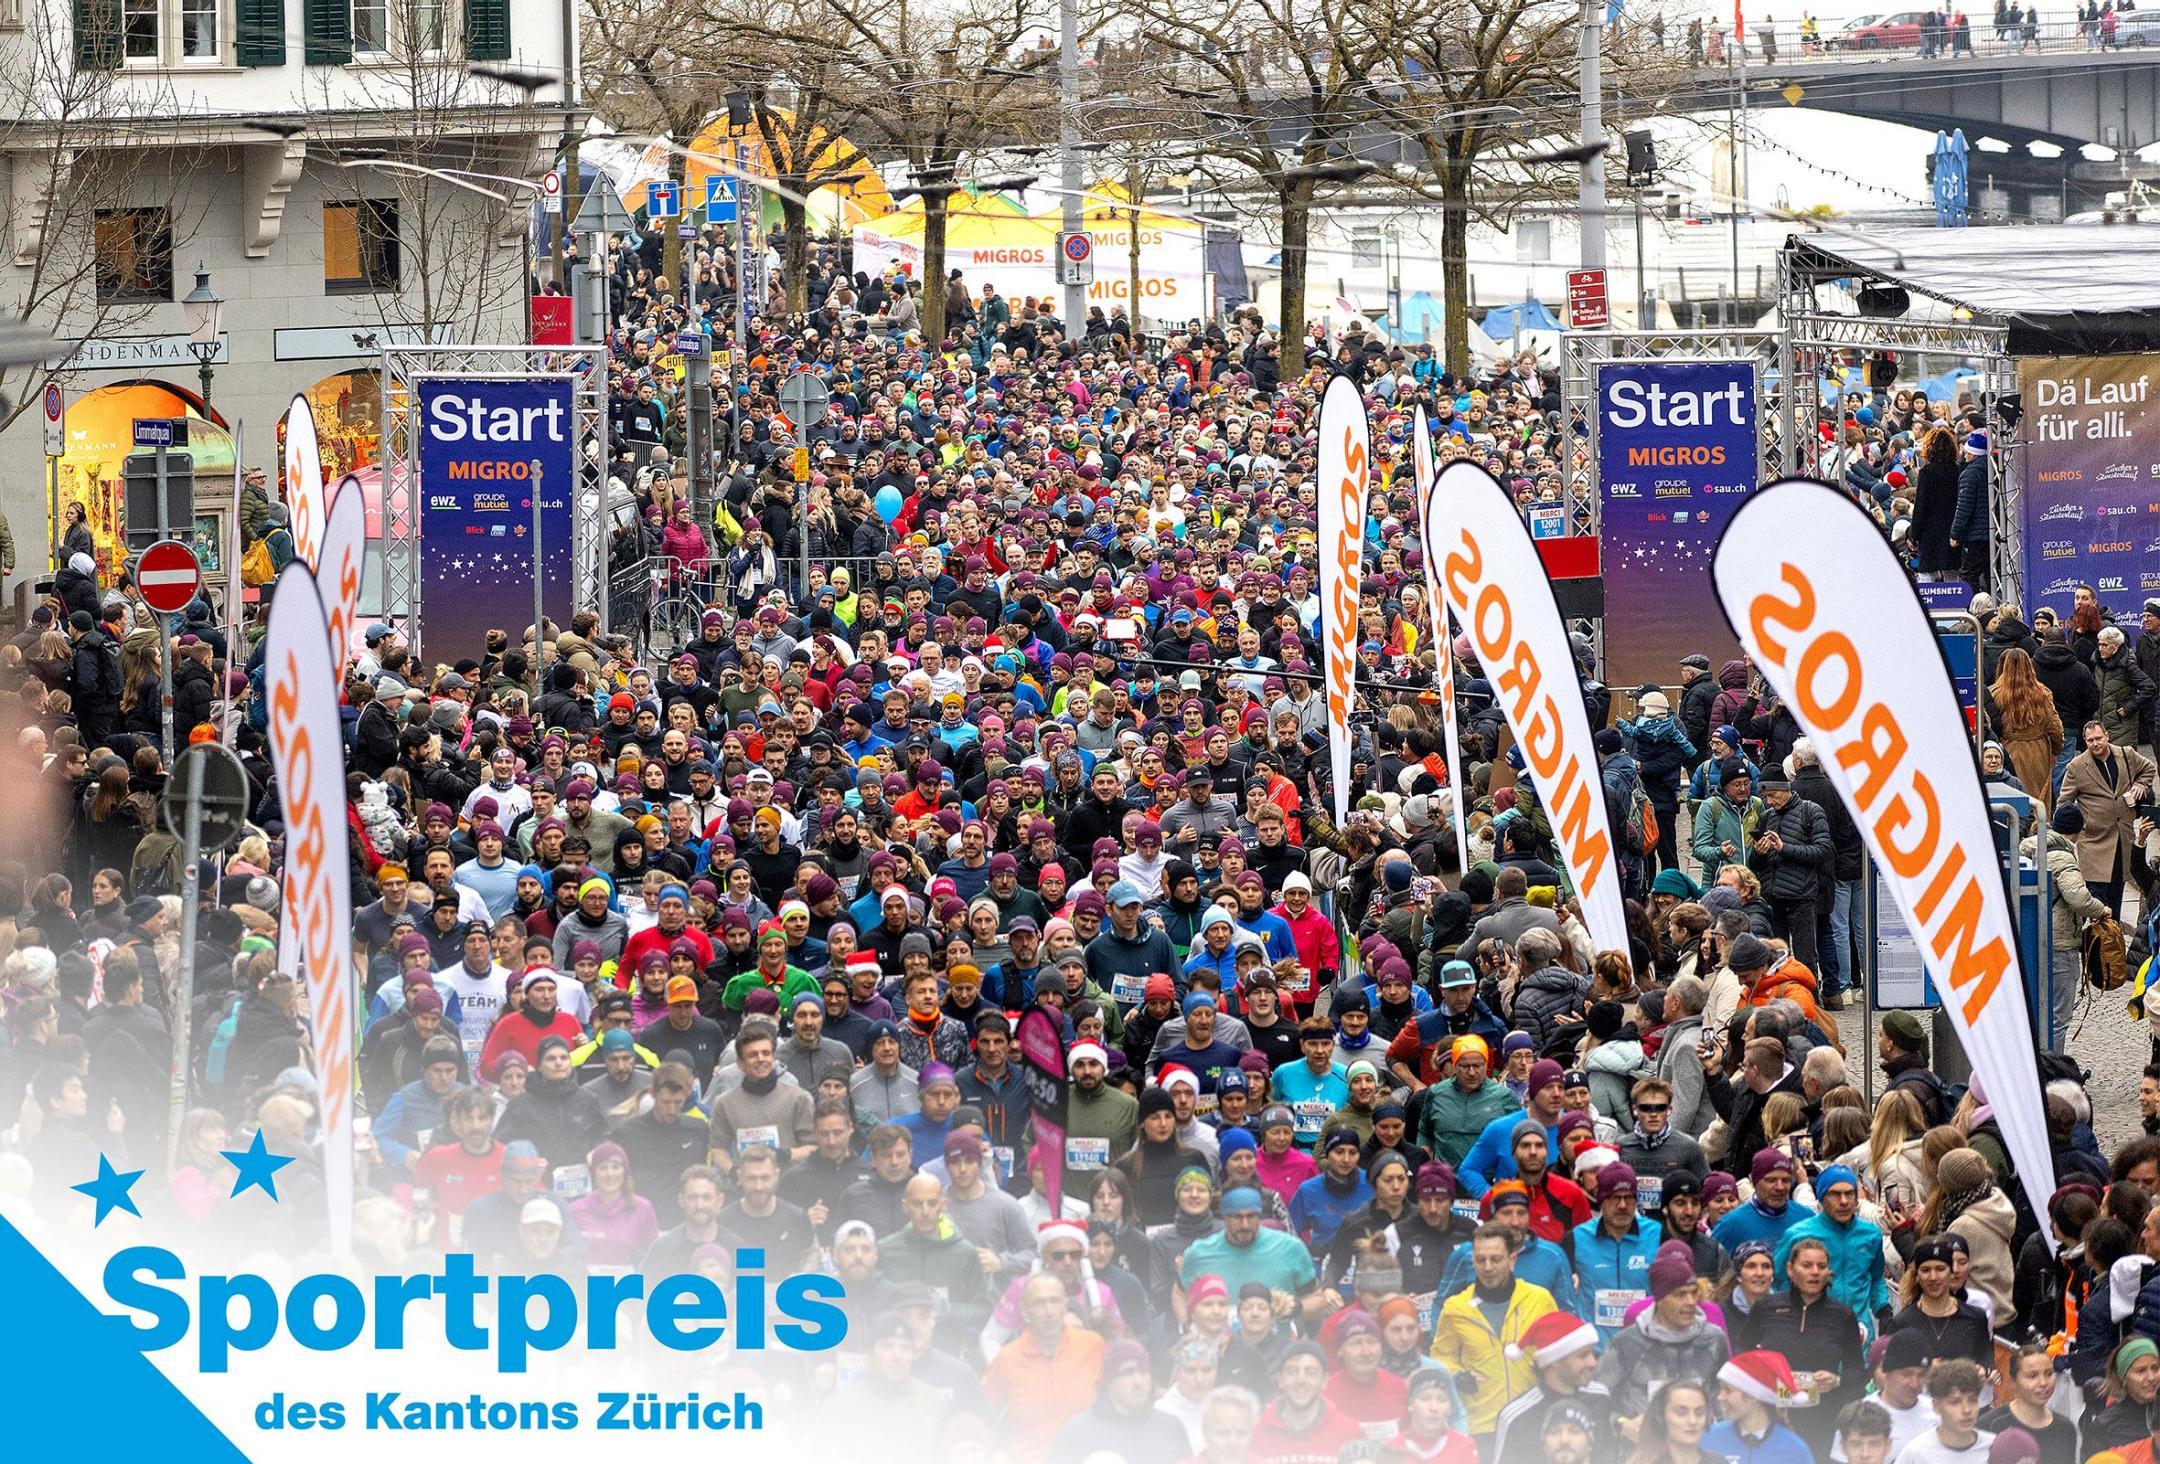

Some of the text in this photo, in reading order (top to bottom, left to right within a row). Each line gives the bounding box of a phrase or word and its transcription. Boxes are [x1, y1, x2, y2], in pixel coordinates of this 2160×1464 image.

[974, 249, 1045, 264] MIGROS
[2037, 374, 2149, 407] Dä Lauf
[1608, 380, 1746, 428] Start
[430, 394, 564, 442] Start
[2037, 411, 2133, 442] für alli.
[1629, 446, 1726, 467] MIGROS
[2038, 470, 2083, 482] MIGROS
[1610, 483, 1637, 494] ewz
[1655, 479, 1687, 489] groupe
[1714, 483, 1747, 493] sau.ch
[1655, 486, 1691, 496] mutuel
[430, 494, 457, 506] ewz
[473, 493, 506, 503] groupe
[474, 501, 509, 509] mutuel
[2107, 504, 2137, 515] sau.ch
[1540, 509, 1562, 518] MERCI
[1540, 519, 1561, 528] 12001
[2042, 540, 2073, 549] groupe
[2088, 541, 2133, 553] MIGROS
[2043, 547, 2076, 557] mutuel
[2099, 577, 2123, 588] ewz
[459, 996, 498, 1009] TEAM
